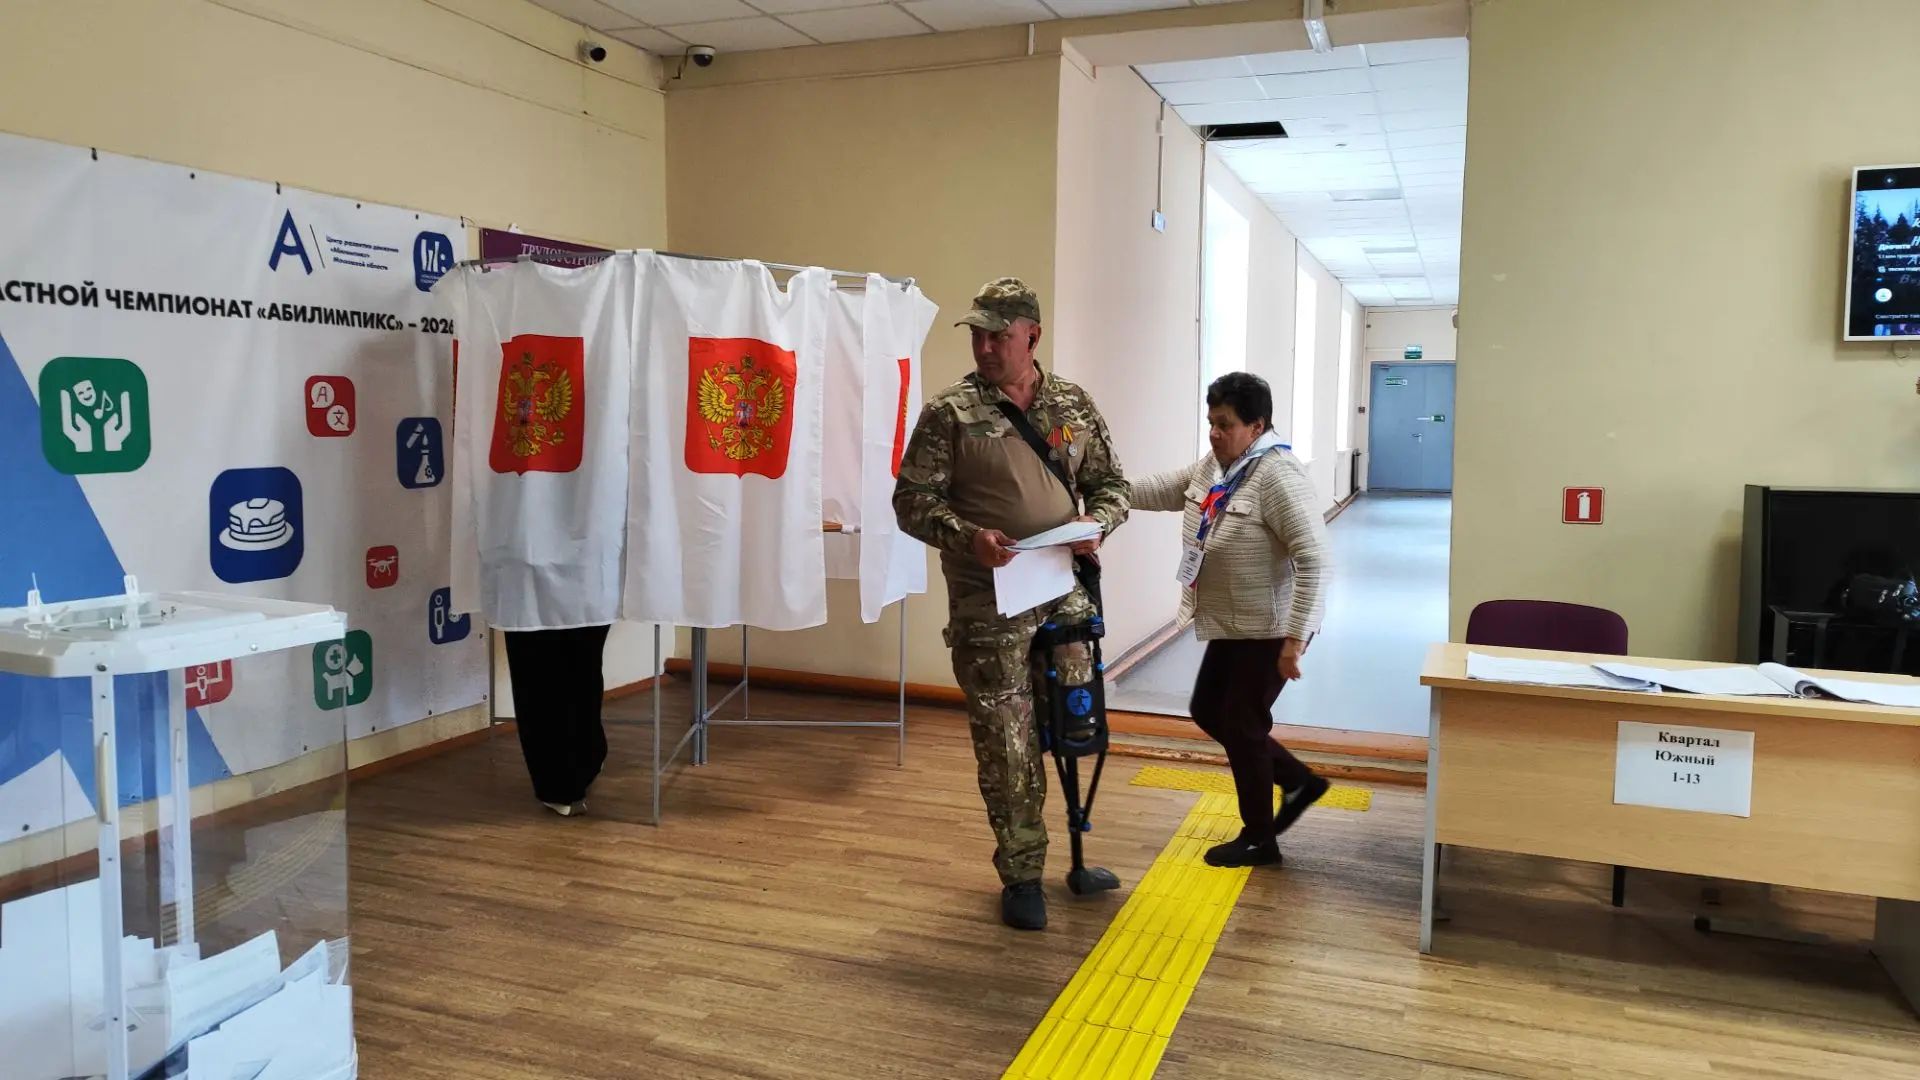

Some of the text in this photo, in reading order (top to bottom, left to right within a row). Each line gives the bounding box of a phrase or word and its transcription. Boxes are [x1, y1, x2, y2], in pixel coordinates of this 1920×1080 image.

[105, 288, 253, 319] ЧЕМПИОНАТ
[257, 303, 403, 331] «АБИЛИМПИКС»
[1658, 731, 1720, 748] Квартал
[1656, 750, 1715, 766] Южный
[1673, 772, 1701, 785] 1-13
